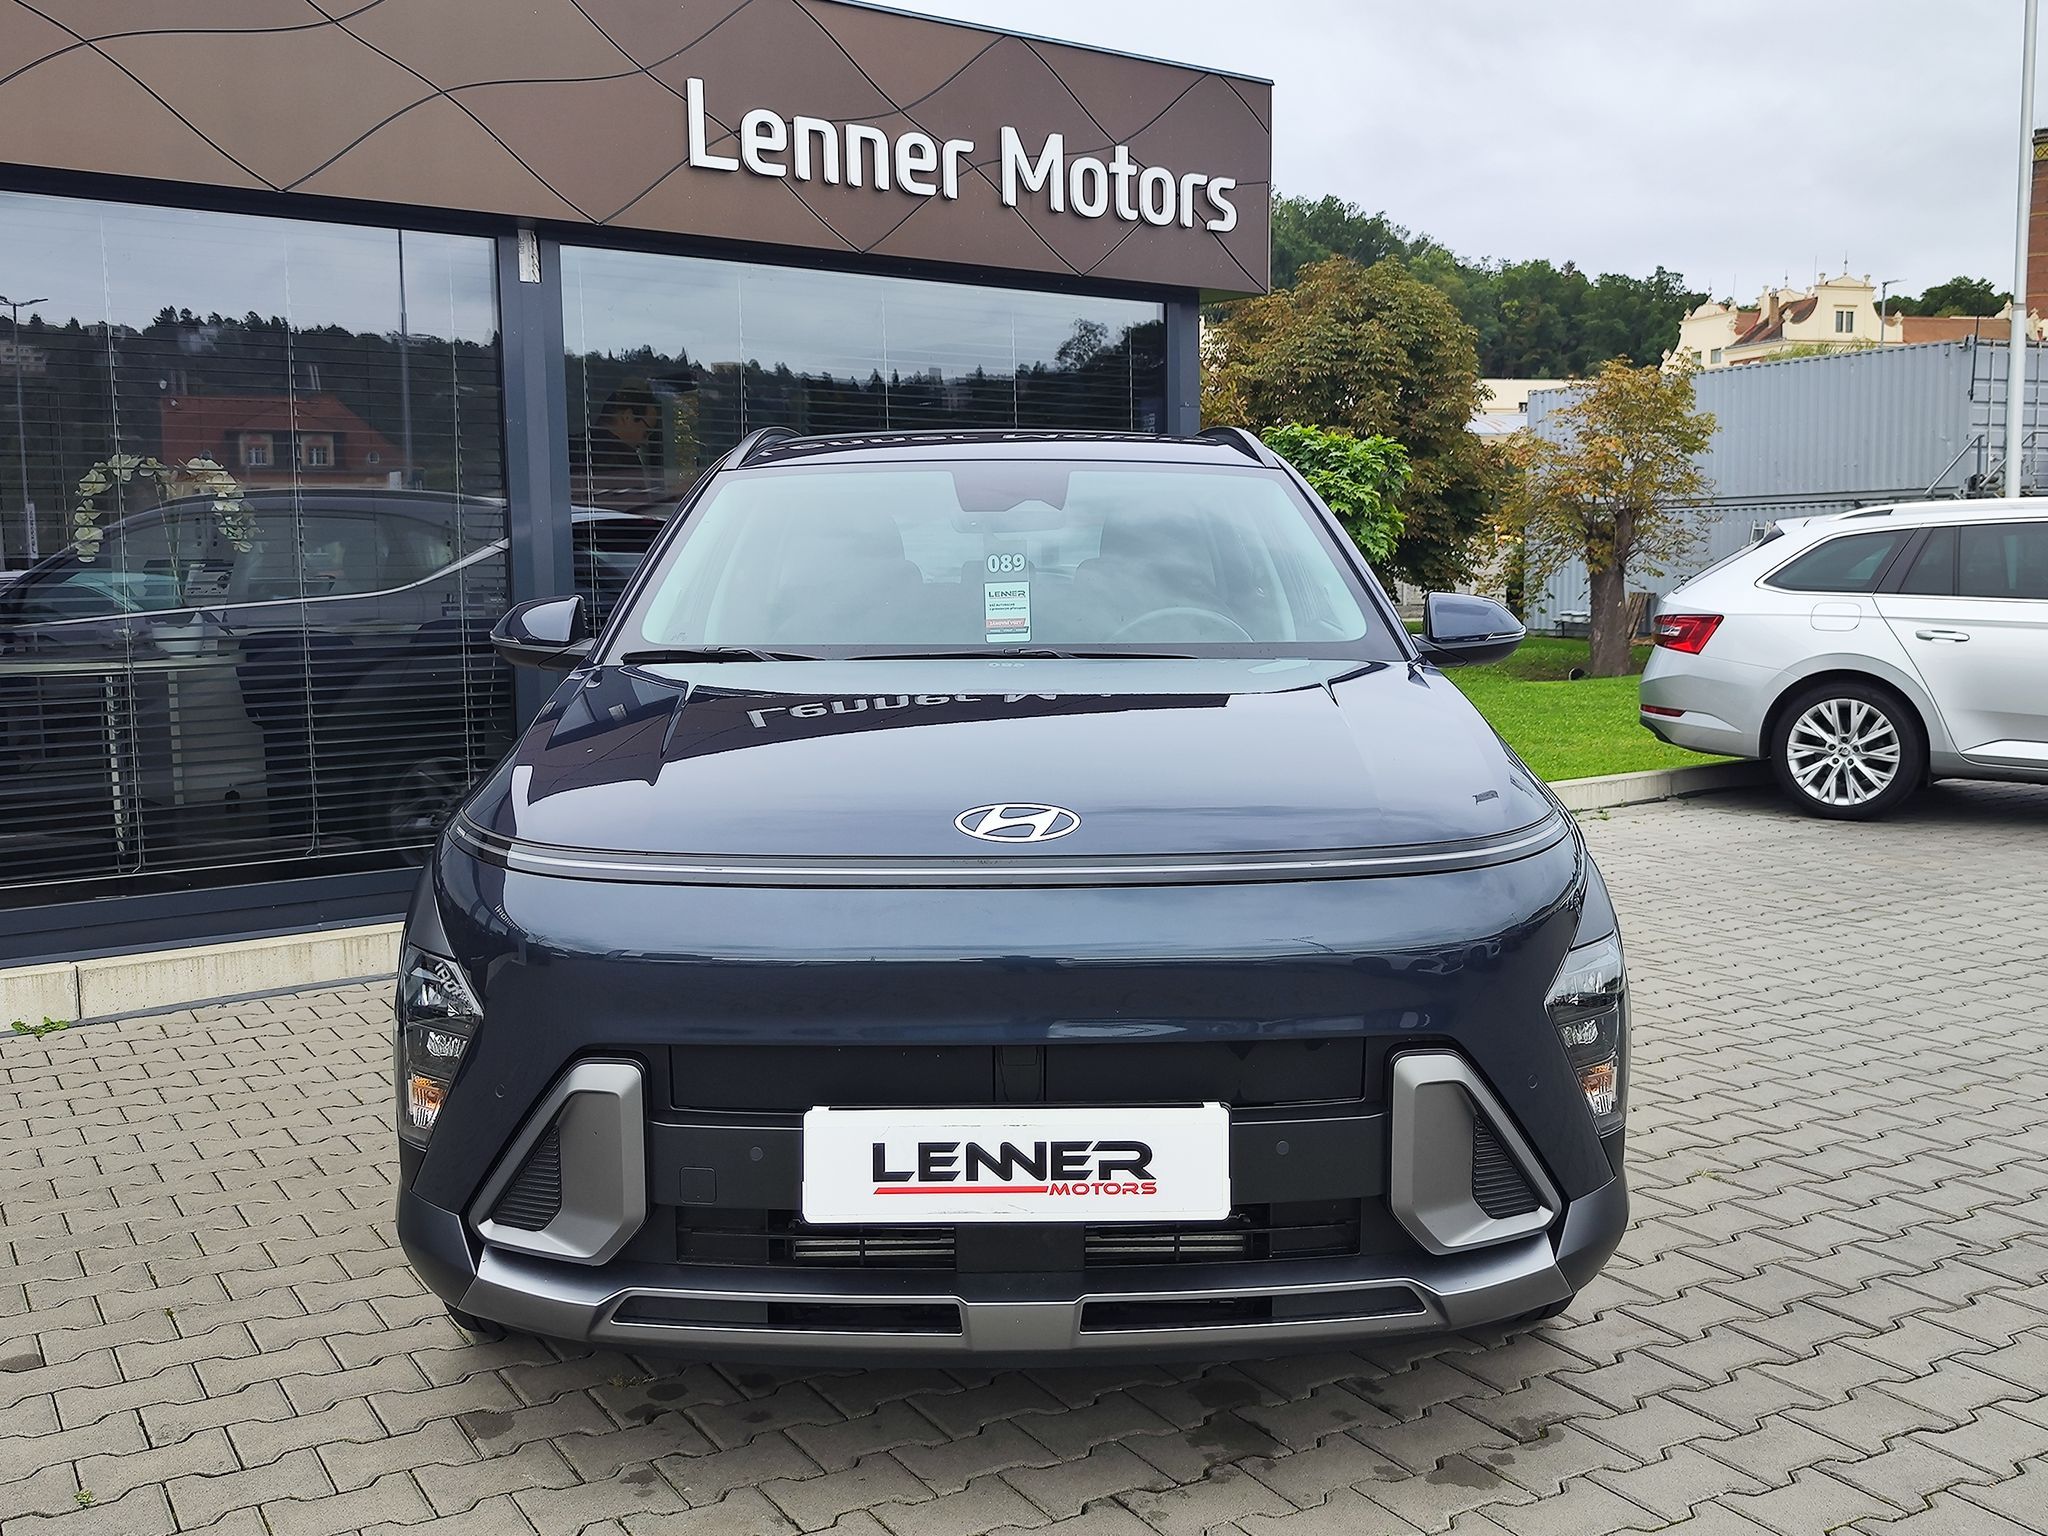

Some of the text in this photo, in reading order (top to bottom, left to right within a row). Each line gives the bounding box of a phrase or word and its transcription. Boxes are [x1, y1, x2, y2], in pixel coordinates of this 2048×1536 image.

[686, 77, 1238, 233] Lenner Motors
[986, 553, 1026, 573] 089
[988, 590, 1026, 599] LENNER
[872, 1140, 1157, 1182] LENNER
[1049, 1182, 1158, 1196] MOTORS
